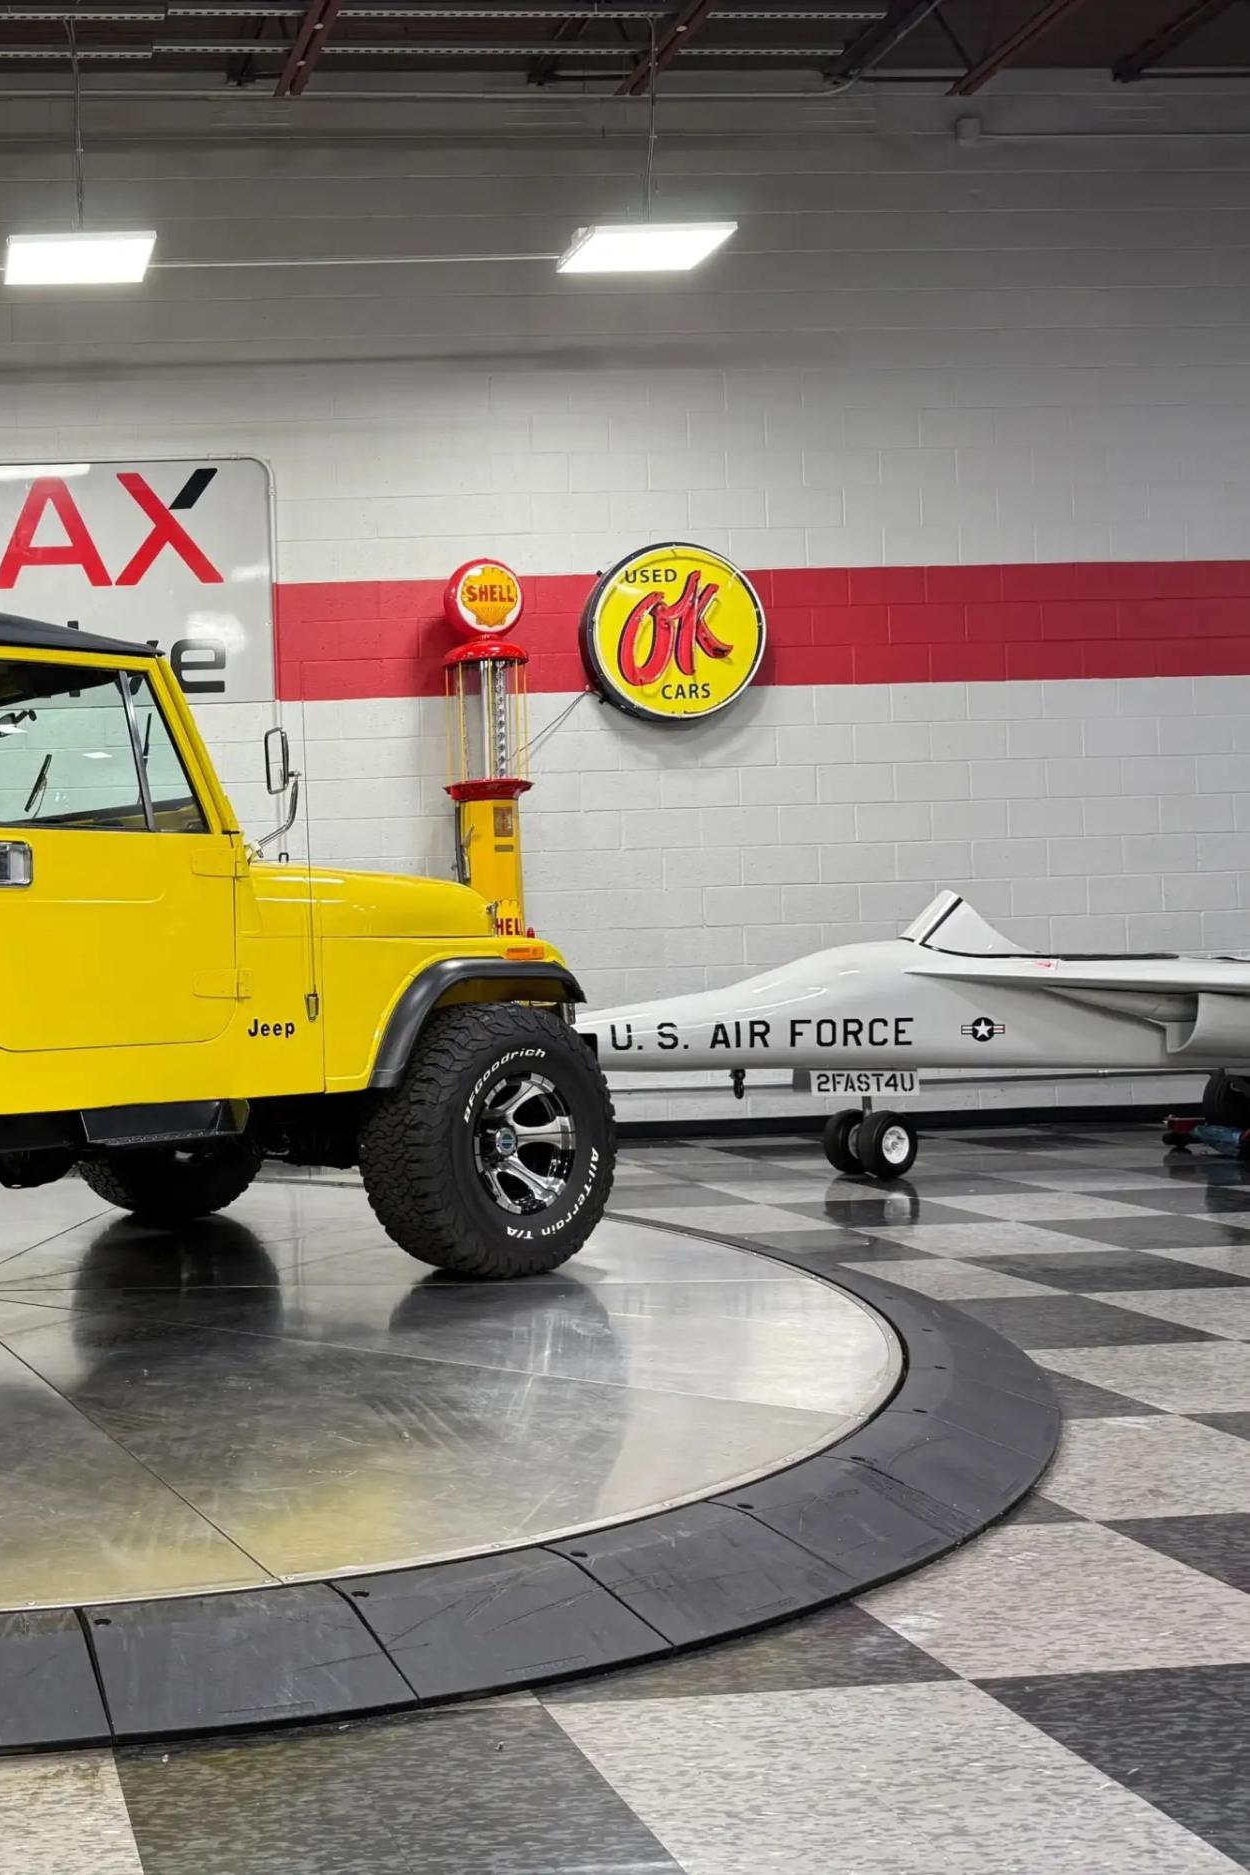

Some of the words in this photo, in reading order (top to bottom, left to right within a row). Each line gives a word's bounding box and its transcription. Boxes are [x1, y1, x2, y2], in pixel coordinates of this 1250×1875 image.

[625, 569, 677, 583] USED
[466, 585, 514, 602] SHELL
[617, 570, 734, 686] OK
[662, 683, 710, 700] CARS
[248, 1018, 295, 1038] Jeep
[611, 1024, 643, 1050] U.
[657, 1022, 689, 1050] S.
[710, 1020, 771, 1048] AIR
[790, 1017, 913, 1047] FORCE
[463, 1048, 546, 1123] BFGoodrich
[817, 1073, 915, 1093] 2FAST4U
[541, 1147, 599, 1236] All-Terrain
[506, 1226, 534, 1240] T/A
